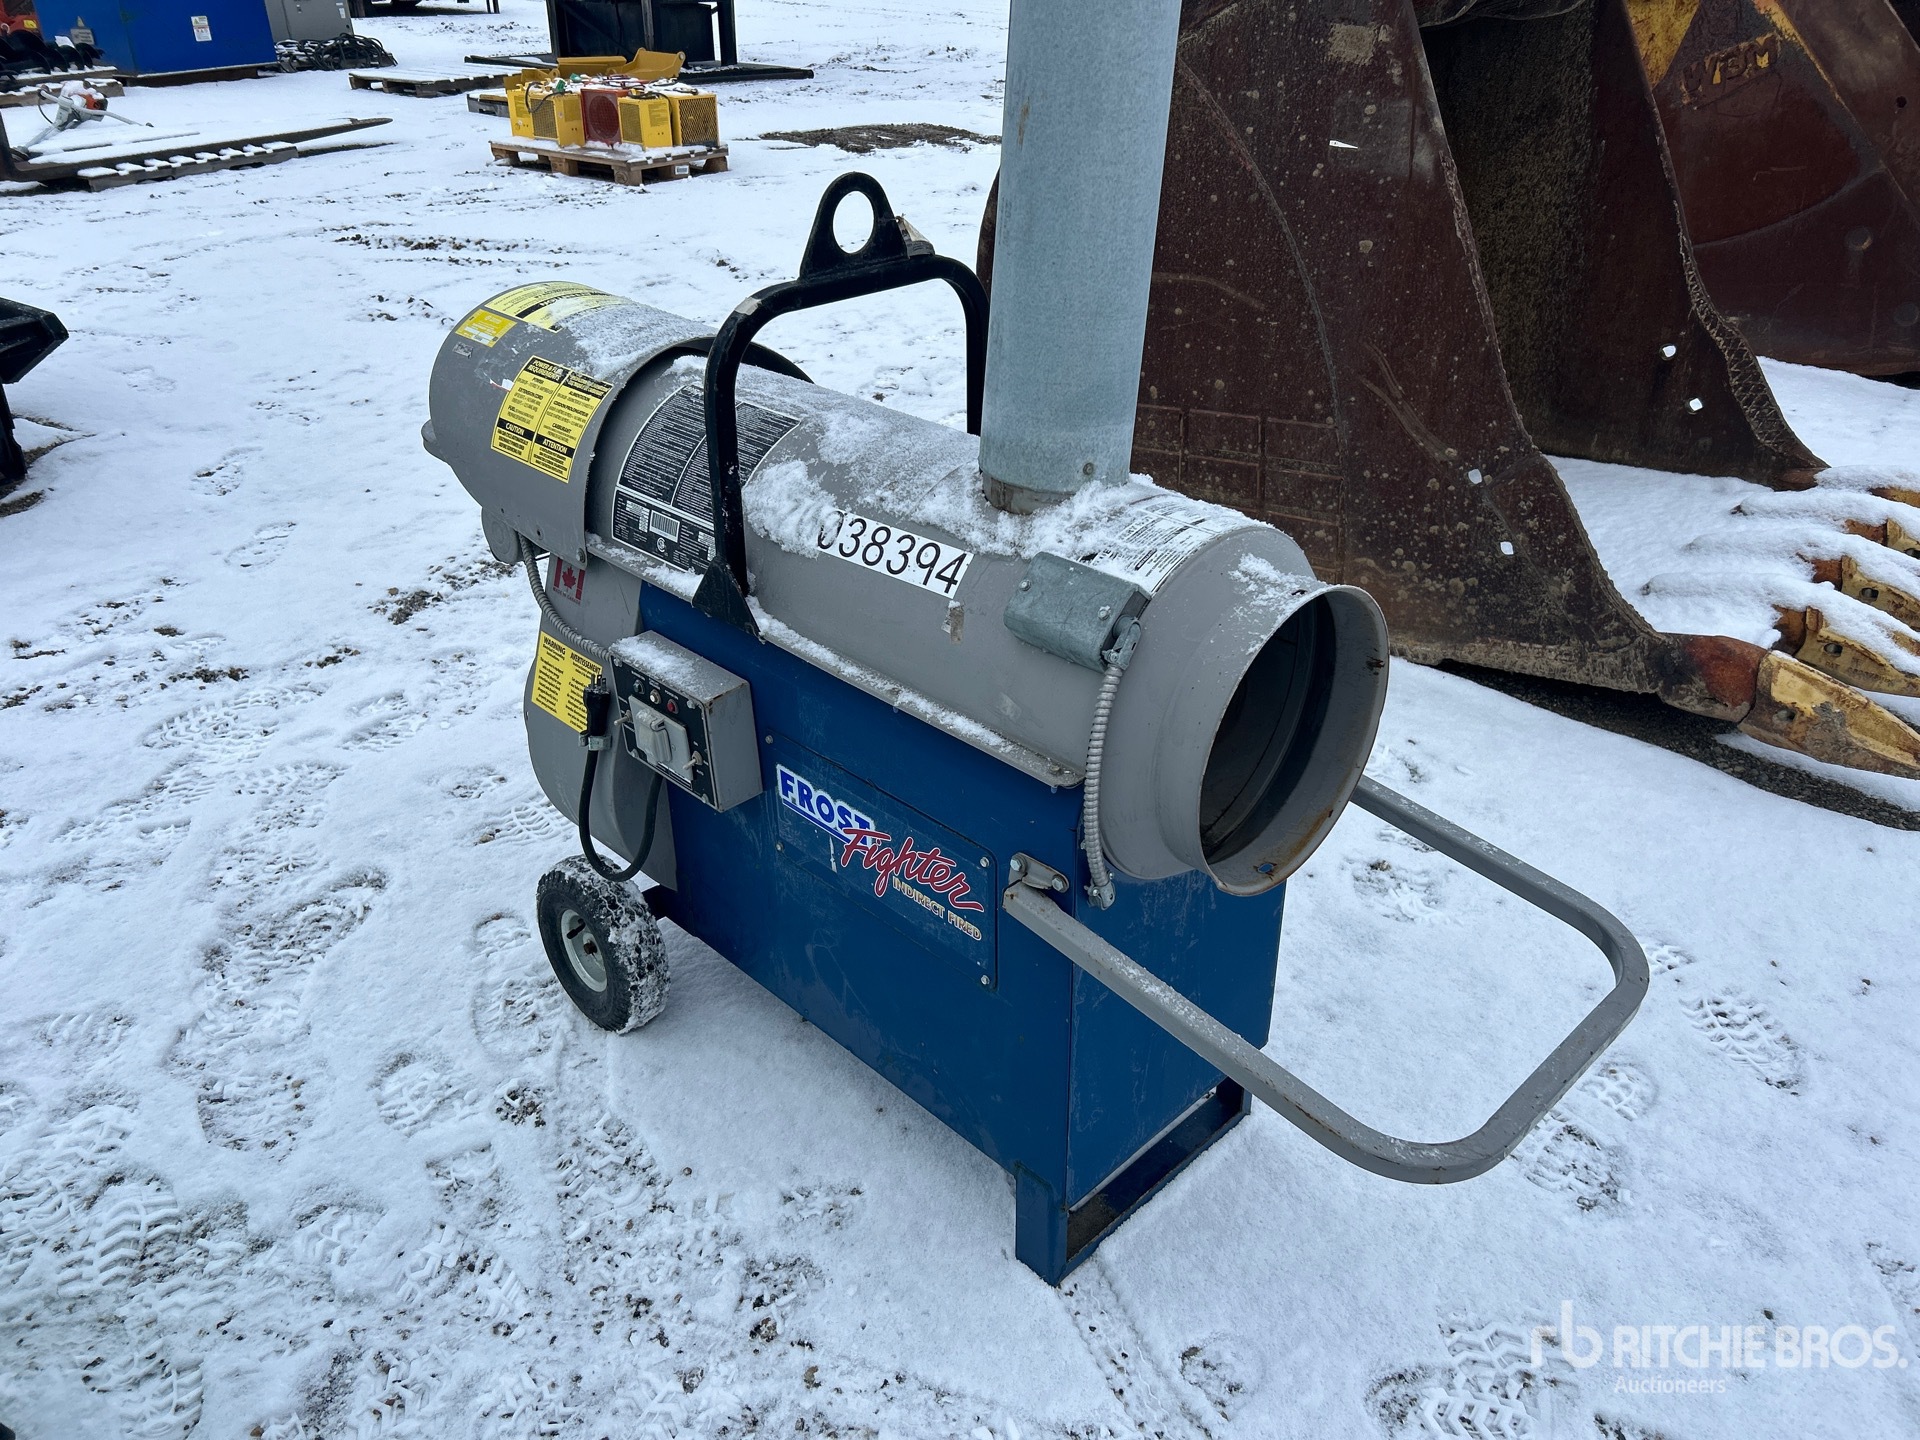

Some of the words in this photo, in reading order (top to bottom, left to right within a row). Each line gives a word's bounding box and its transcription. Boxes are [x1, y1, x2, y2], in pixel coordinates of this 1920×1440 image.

[505, 422, 525, 436] CAUTION
[542, 438, 568, 454] ATTENTION
[543, 635, 566, 655] WARNING
[570, 652, 601, 675] AVERTISSEMENT
[779, 767, 872, 846] FROST
[841, 828, 984, 912] Fighter
[892, 875, 945, 919] INDIRECT
[947, 910, 982, 940] FIRED
